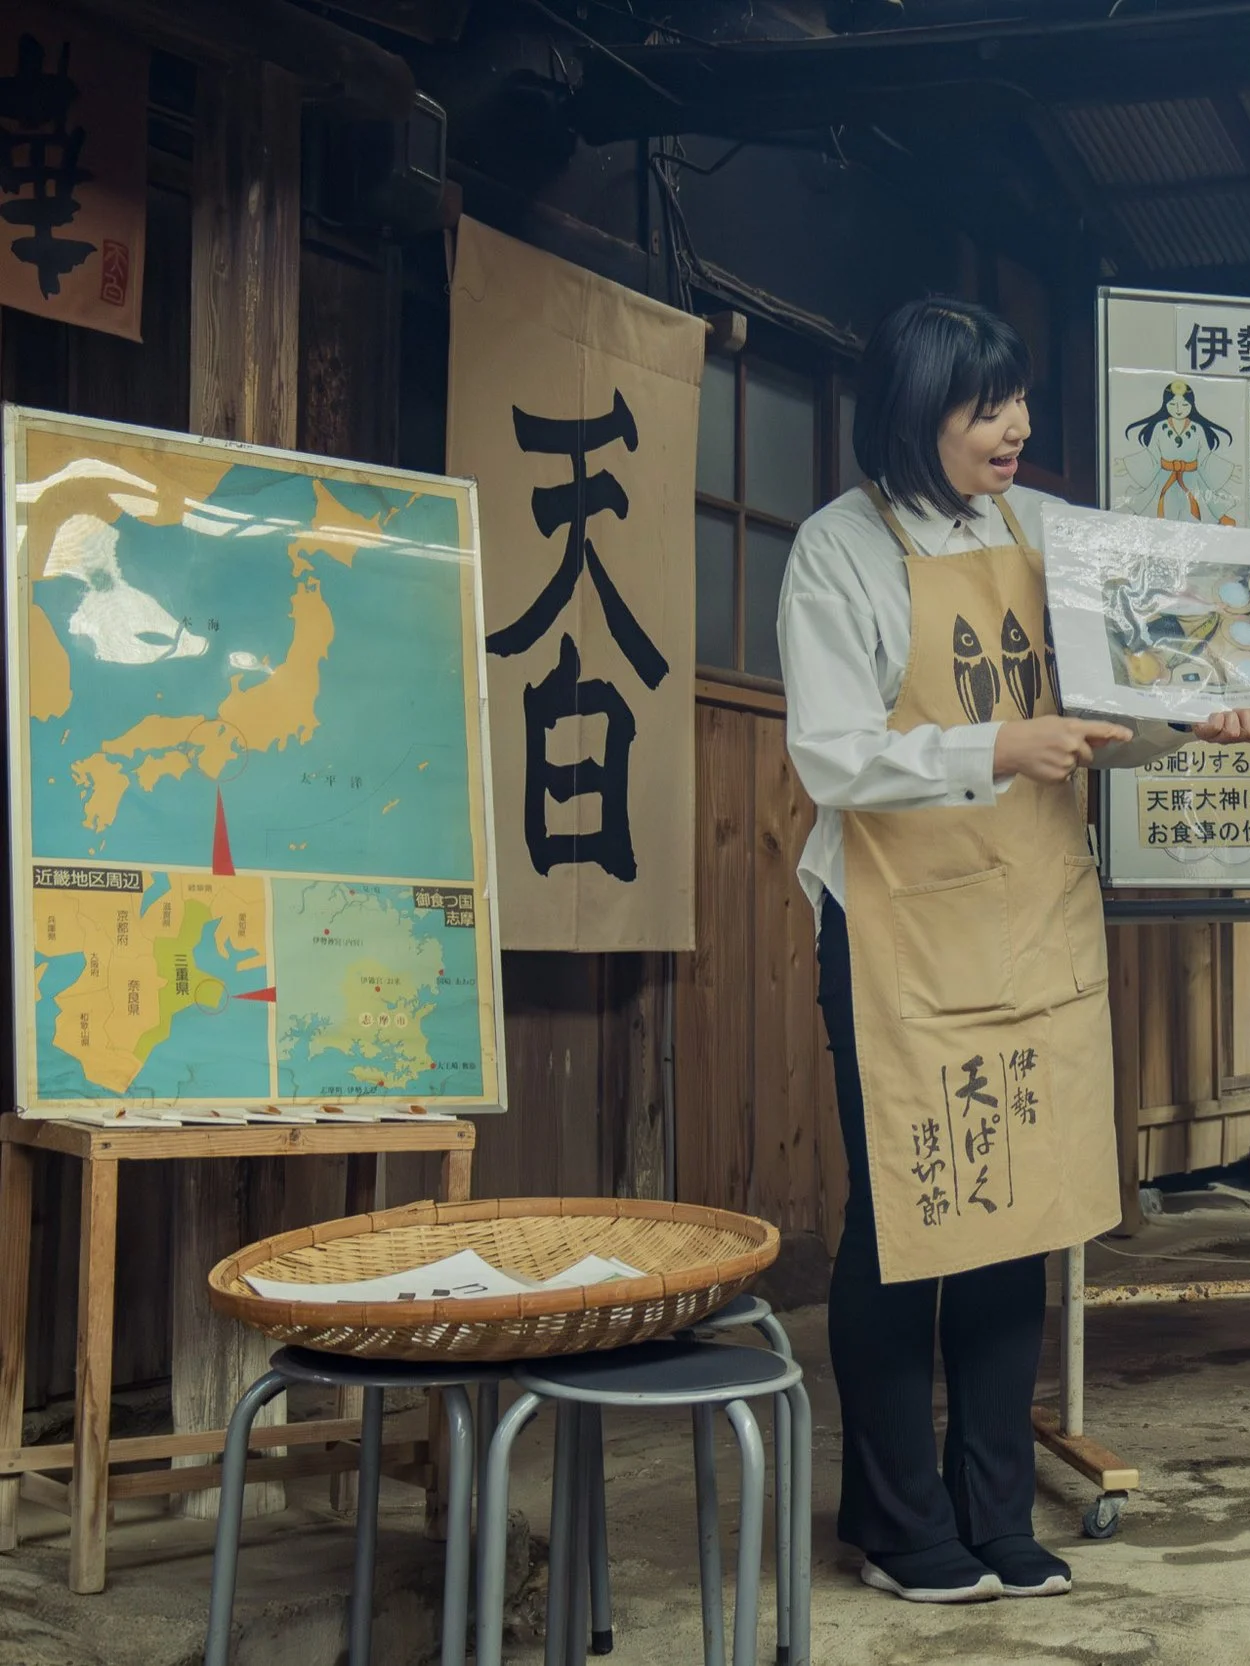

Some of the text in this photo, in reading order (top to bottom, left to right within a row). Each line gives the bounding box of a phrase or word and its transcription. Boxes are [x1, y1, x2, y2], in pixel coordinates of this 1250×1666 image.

[34, 868, 140, 890] 近畿地区周辺
[415, 892, 473, 910] 御食つ国
[446, 910, 474, 927] 志摩
[116, 909, 129, 946] 京都府
[173, 953, 190, 996] 三重県
[127, 979, 141, 1016] 奈良県
[1009, 1047, 1039, 1126] 伊勢
[954, 1054, 1001, 1214] 天ぱく
[911, 1117, 951, 1227] 波切節
